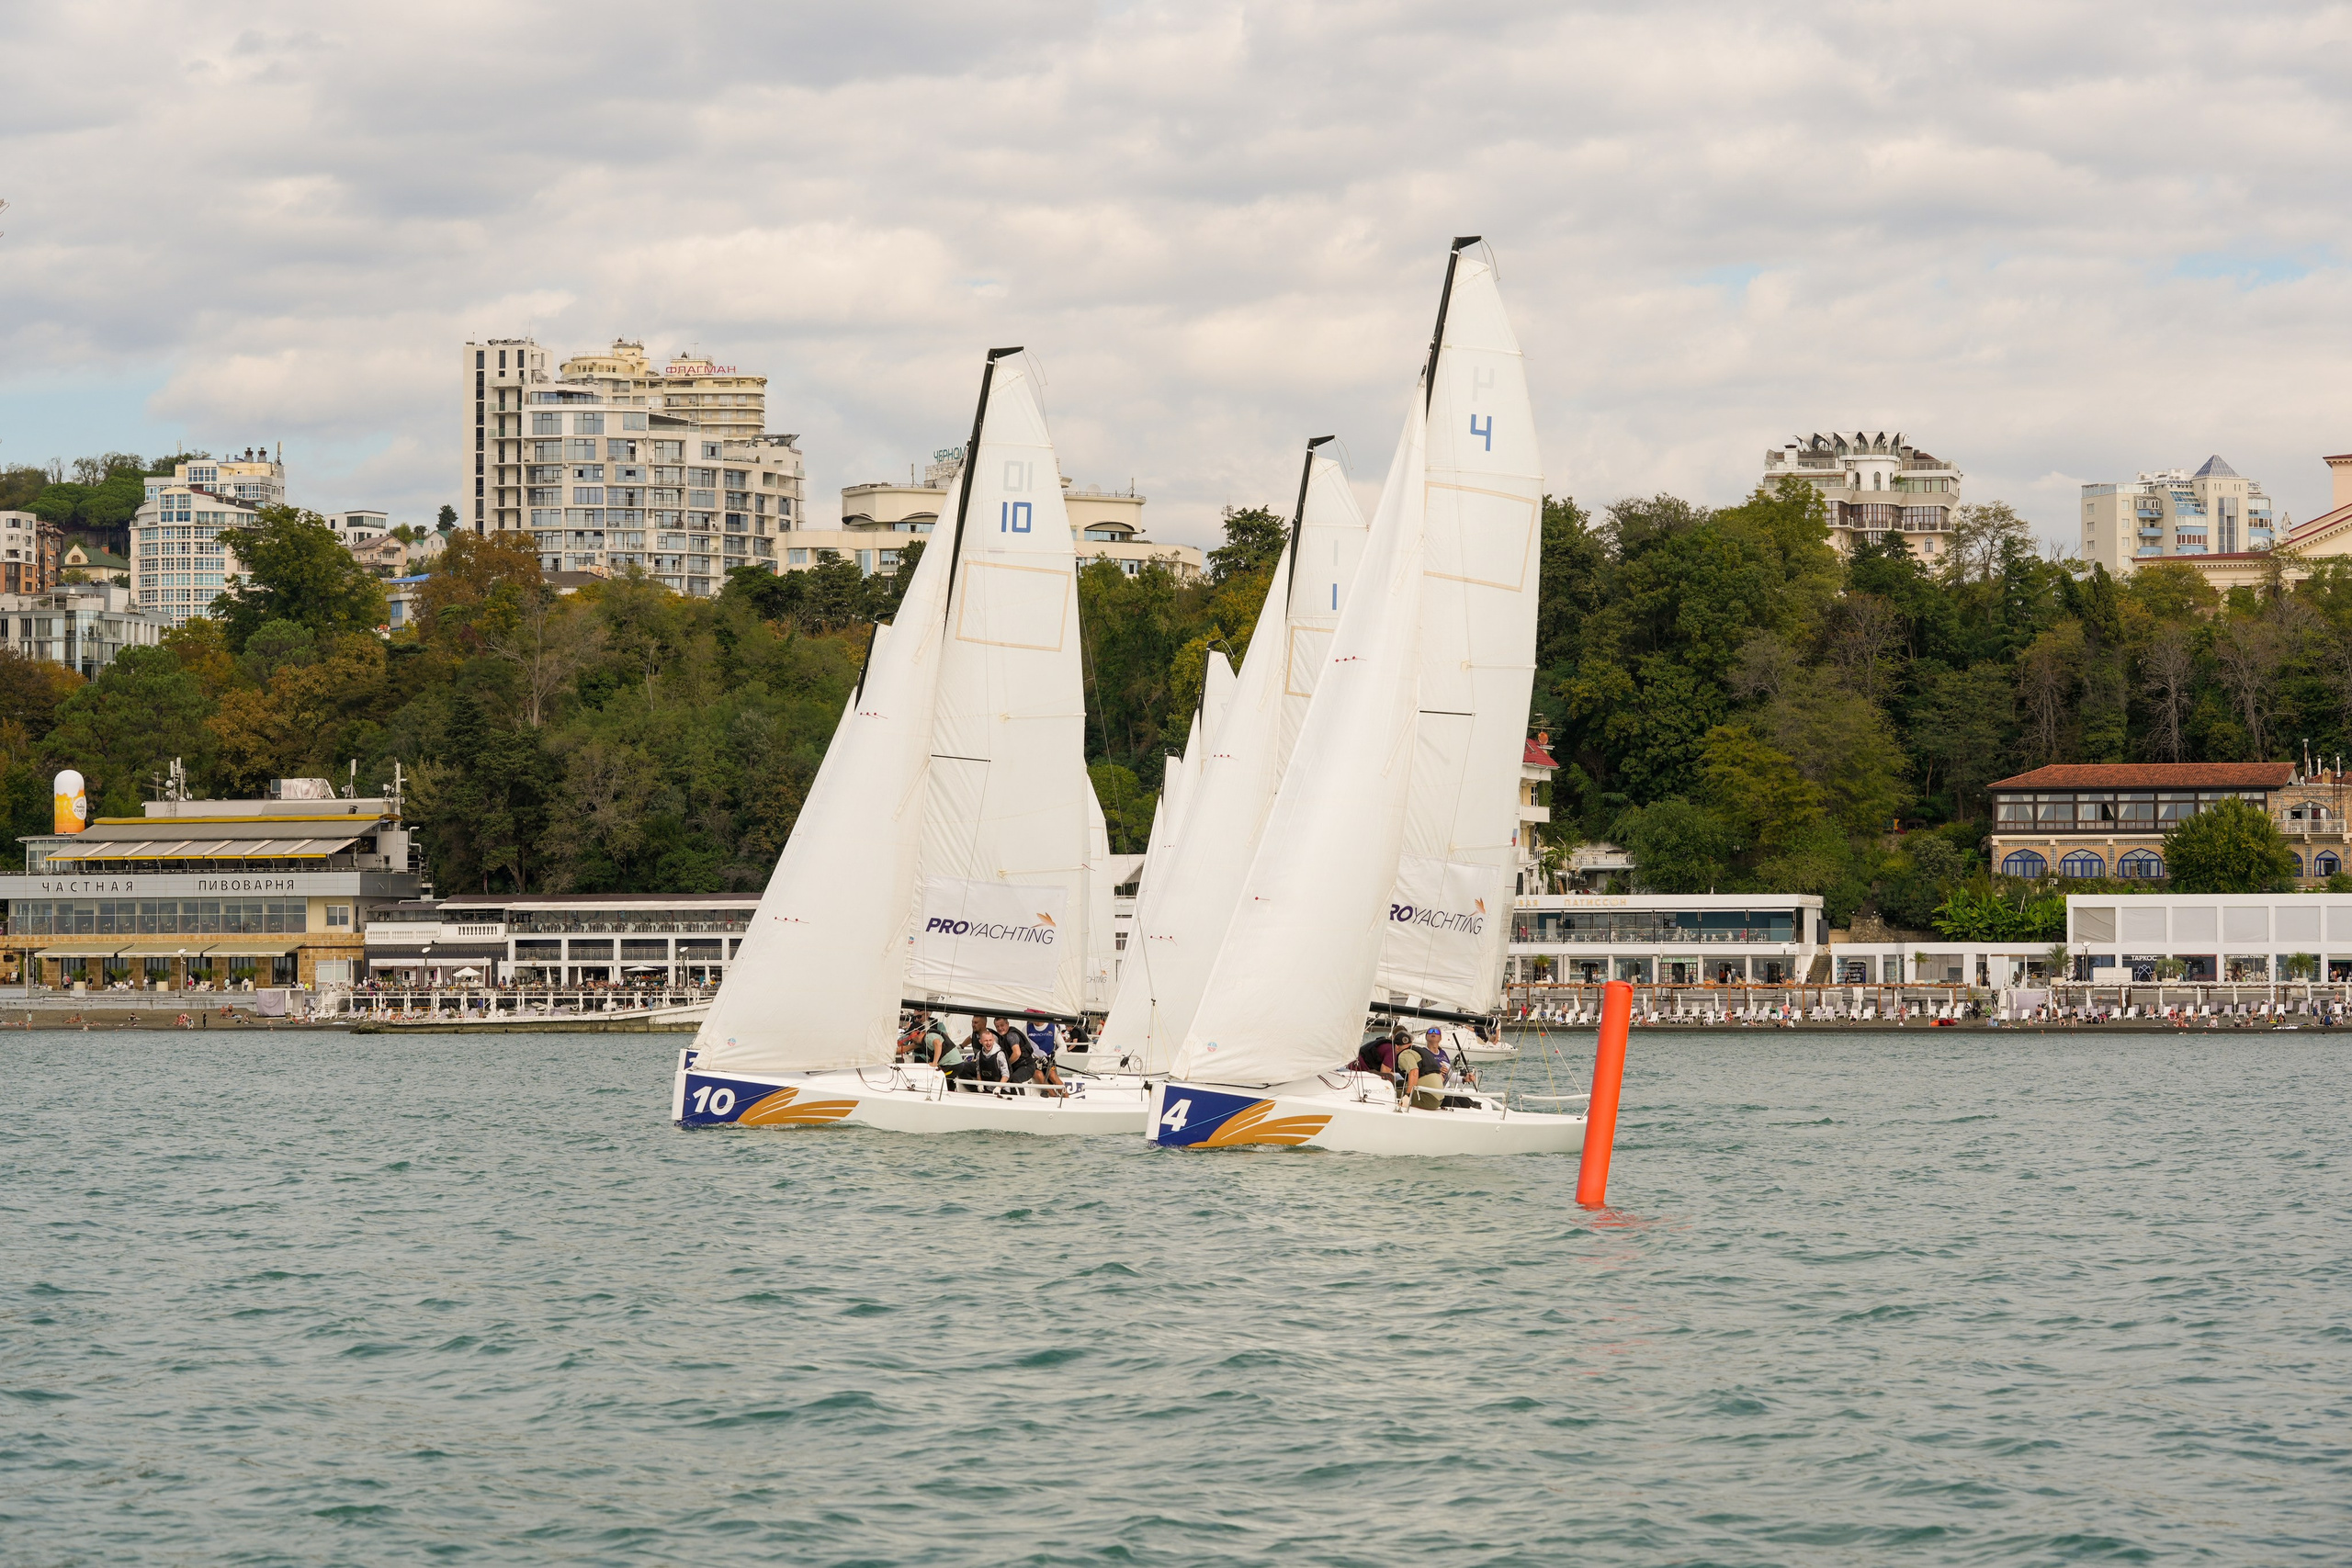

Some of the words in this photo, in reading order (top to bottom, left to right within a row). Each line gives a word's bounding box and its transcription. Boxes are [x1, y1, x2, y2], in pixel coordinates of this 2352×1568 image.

[665, 366, 736, 374] ФЛАГМАН
[1470, 413, 1492, 451] 4
[1001, 502, 1032, 533] 10
[42, 881, 134, 892] ЧАСТНАЯ
[198, 879, 295, 891] ПИВОВАРНЯ
[925, 917, 1055, 944] PROYACHTING
[693, 1086, 736, 1116] 10
[1160, 1098, 1192, 1132] 4
